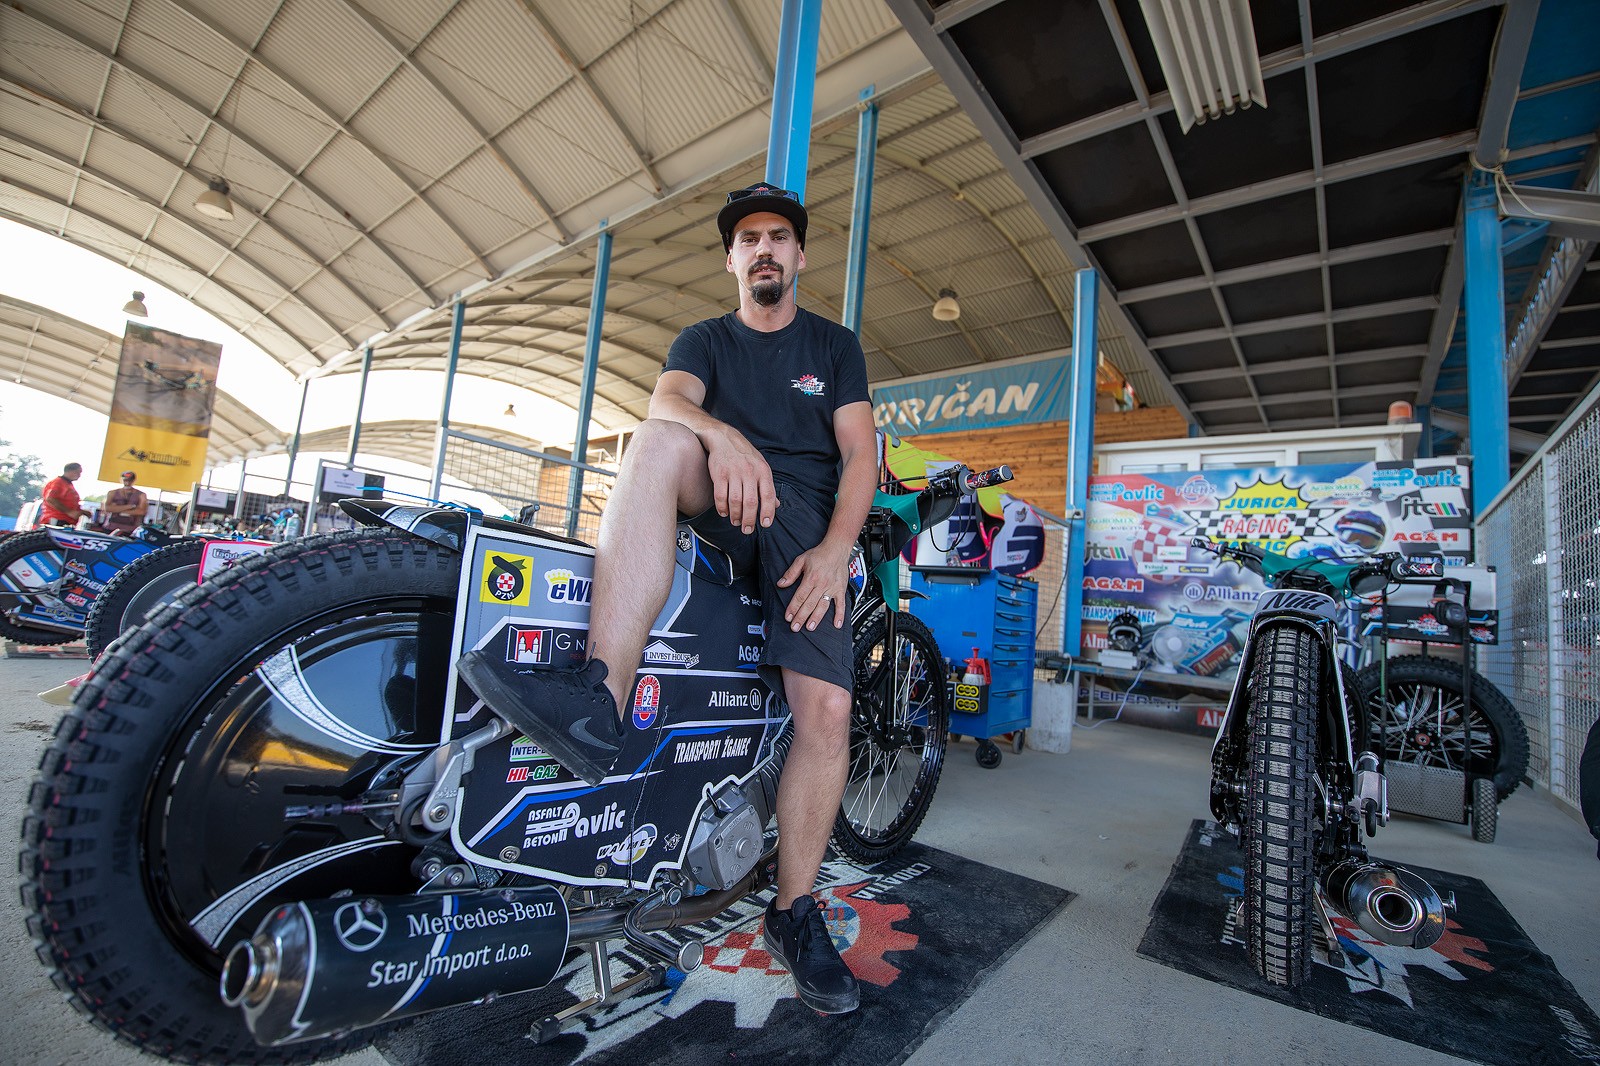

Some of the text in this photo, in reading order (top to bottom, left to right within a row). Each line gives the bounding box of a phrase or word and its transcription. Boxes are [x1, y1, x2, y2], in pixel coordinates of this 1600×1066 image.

[1400, 468, 1462, 487] Pavlic
[1112, 483, 1165, 501] Pavlic
[1225, 496, 1298, 510] JURICA
[1223, 517, 1291, 534] RACING
[83, 539, 112, 552] 55
[1083, 576, 1144, 592] AG&M
[494, 590, 515, 600] PZM
[1206, 586, 1260, 601] Allianz
[649, 651, 671, 660] INVEST
[738, 644, 763, 662] AG&
[708, 690, 748, 707] Allianz
[674, 734, 752, 764] TRANSPORTI ŽGANEC
[507, 764, 560, 782] HIL-GAZ
[527, 806, 562, 822] ASFALT
[850, 862, 932, 900] CROATIA
[407, 899, 556, 939] Mercedes-Benz
[367, 942, 533, 989] Star Import d.o.o.
